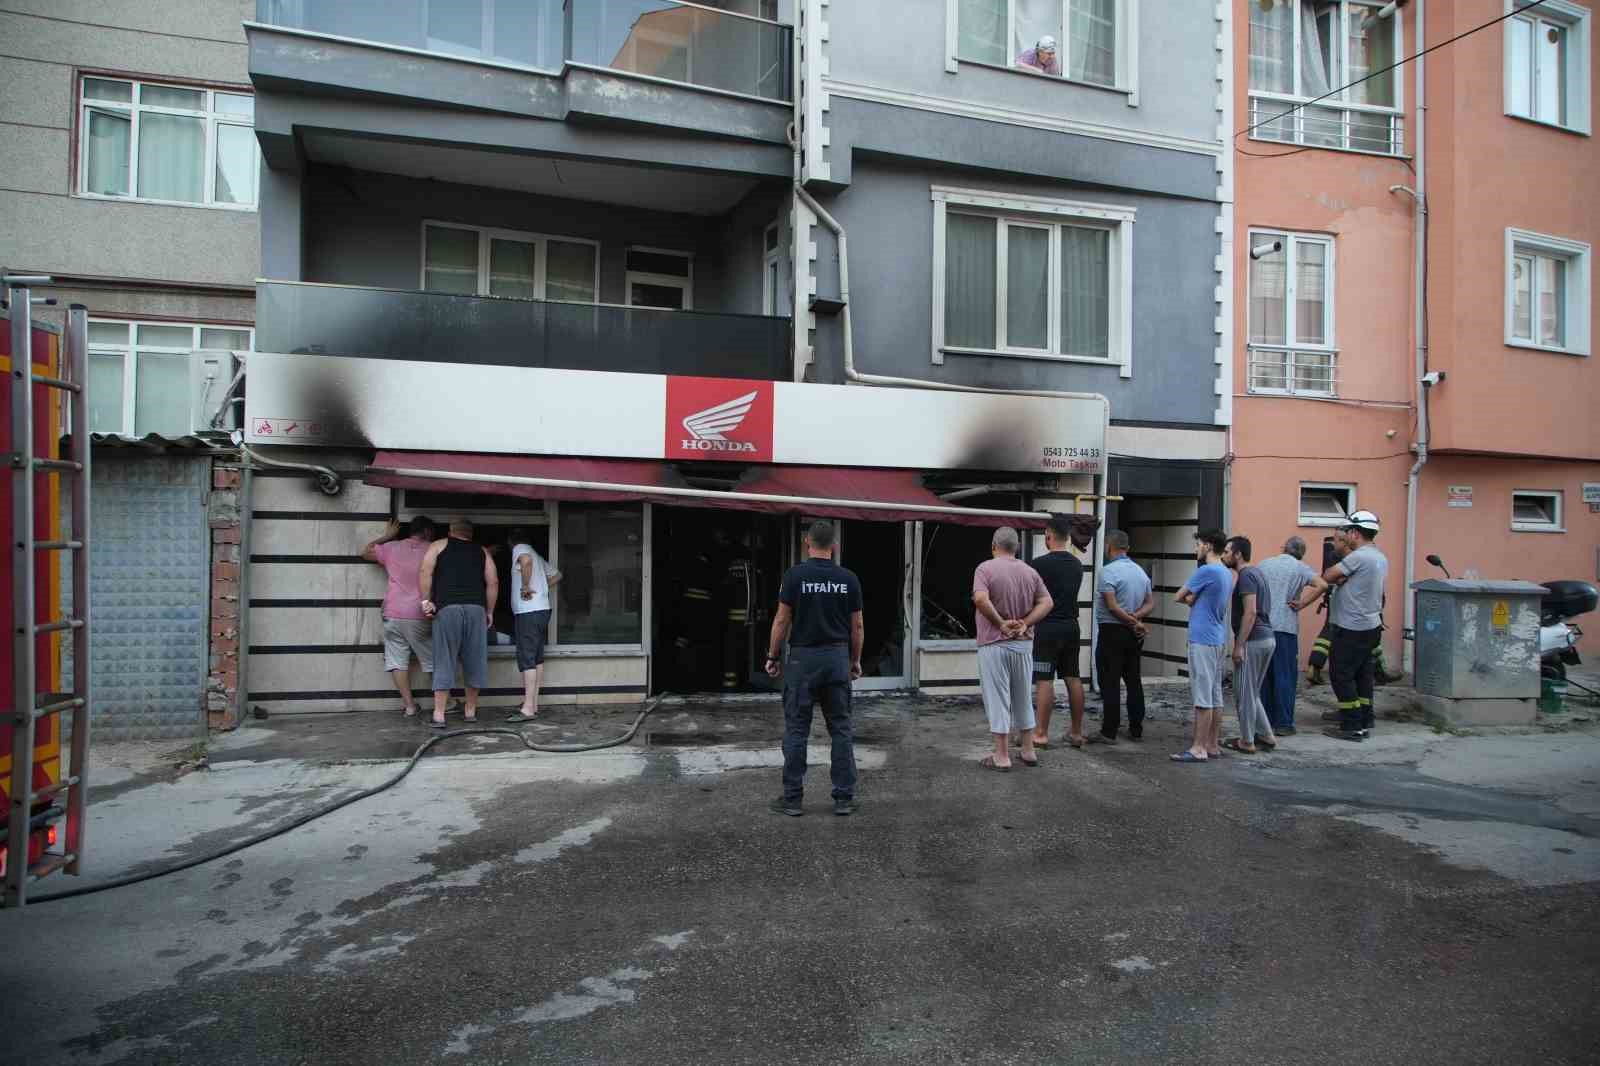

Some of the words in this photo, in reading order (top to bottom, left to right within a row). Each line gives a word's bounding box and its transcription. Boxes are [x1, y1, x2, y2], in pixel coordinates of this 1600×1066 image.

[681, 439, 758, 452] HONDA
[1043, 447, 1062, 457] 0543
[1064, 447, 1078, 457] 725
[1080, 448, 1089, 457] 44
[1090, 448, 1100, 457] 33
[1042, 458, 1066, 468] Moto
[801, 580, 848, 594] İTFAİYE
